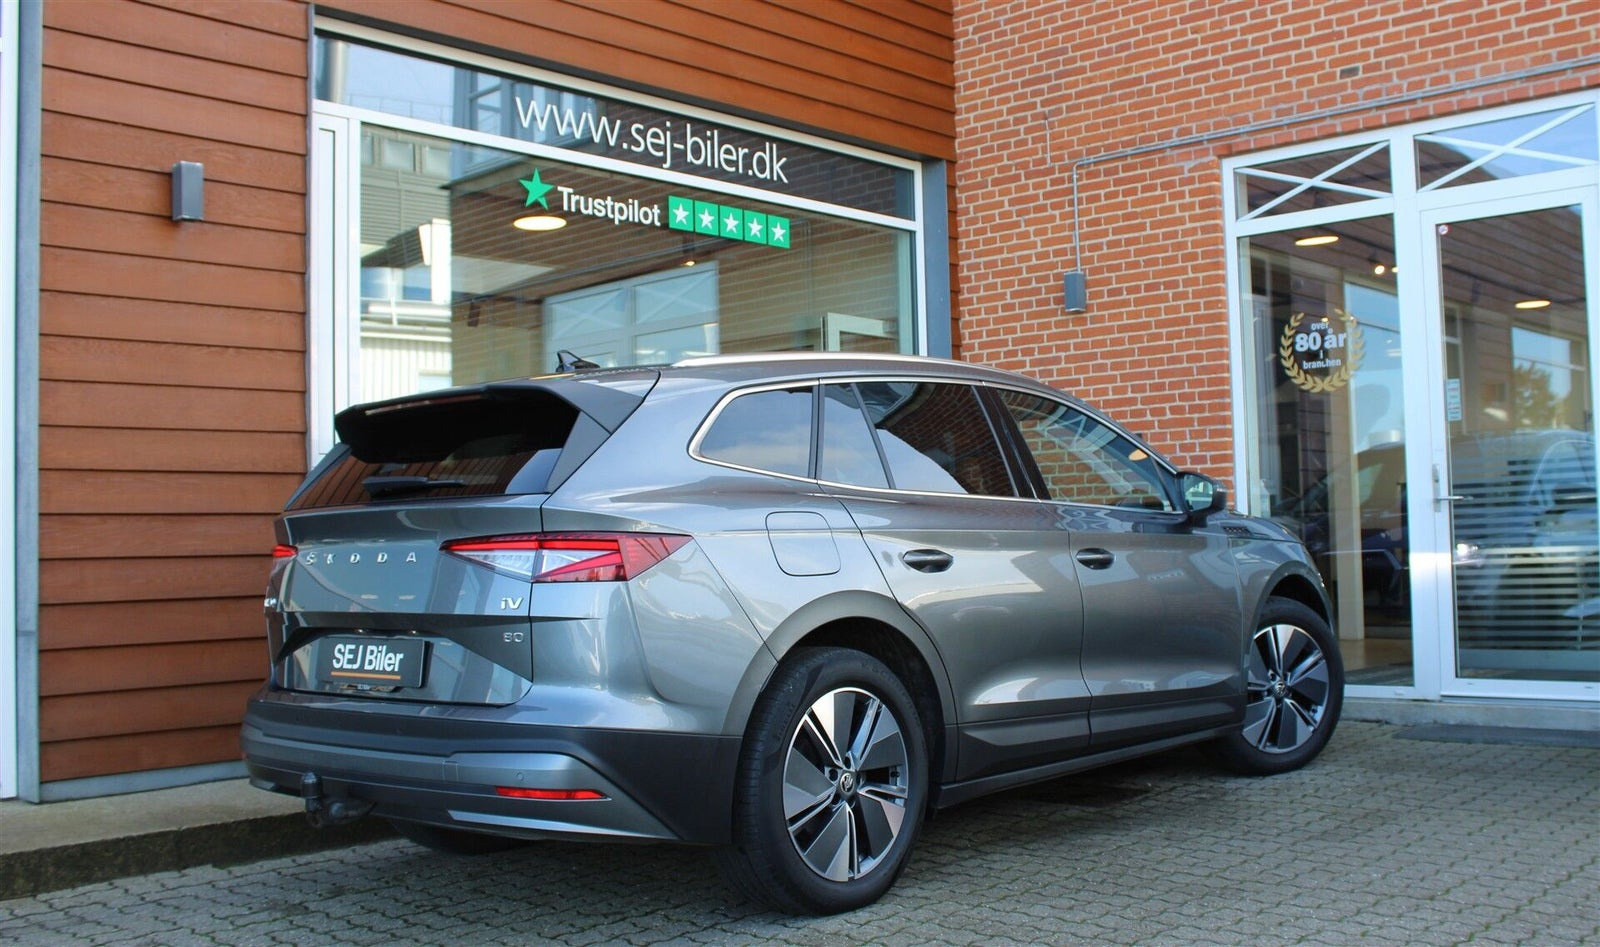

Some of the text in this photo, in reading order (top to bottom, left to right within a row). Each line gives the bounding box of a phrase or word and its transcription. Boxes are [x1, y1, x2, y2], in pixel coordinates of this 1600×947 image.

[515, 97, 789, 184] www.sej-biler.dk
[557, 186, 661, 226] Trustpilot
[1295, 328, 1347, 352] 80 år
[503, 632, 524, 643] 80
[332, 643, 404, 672] SEJ Biler
